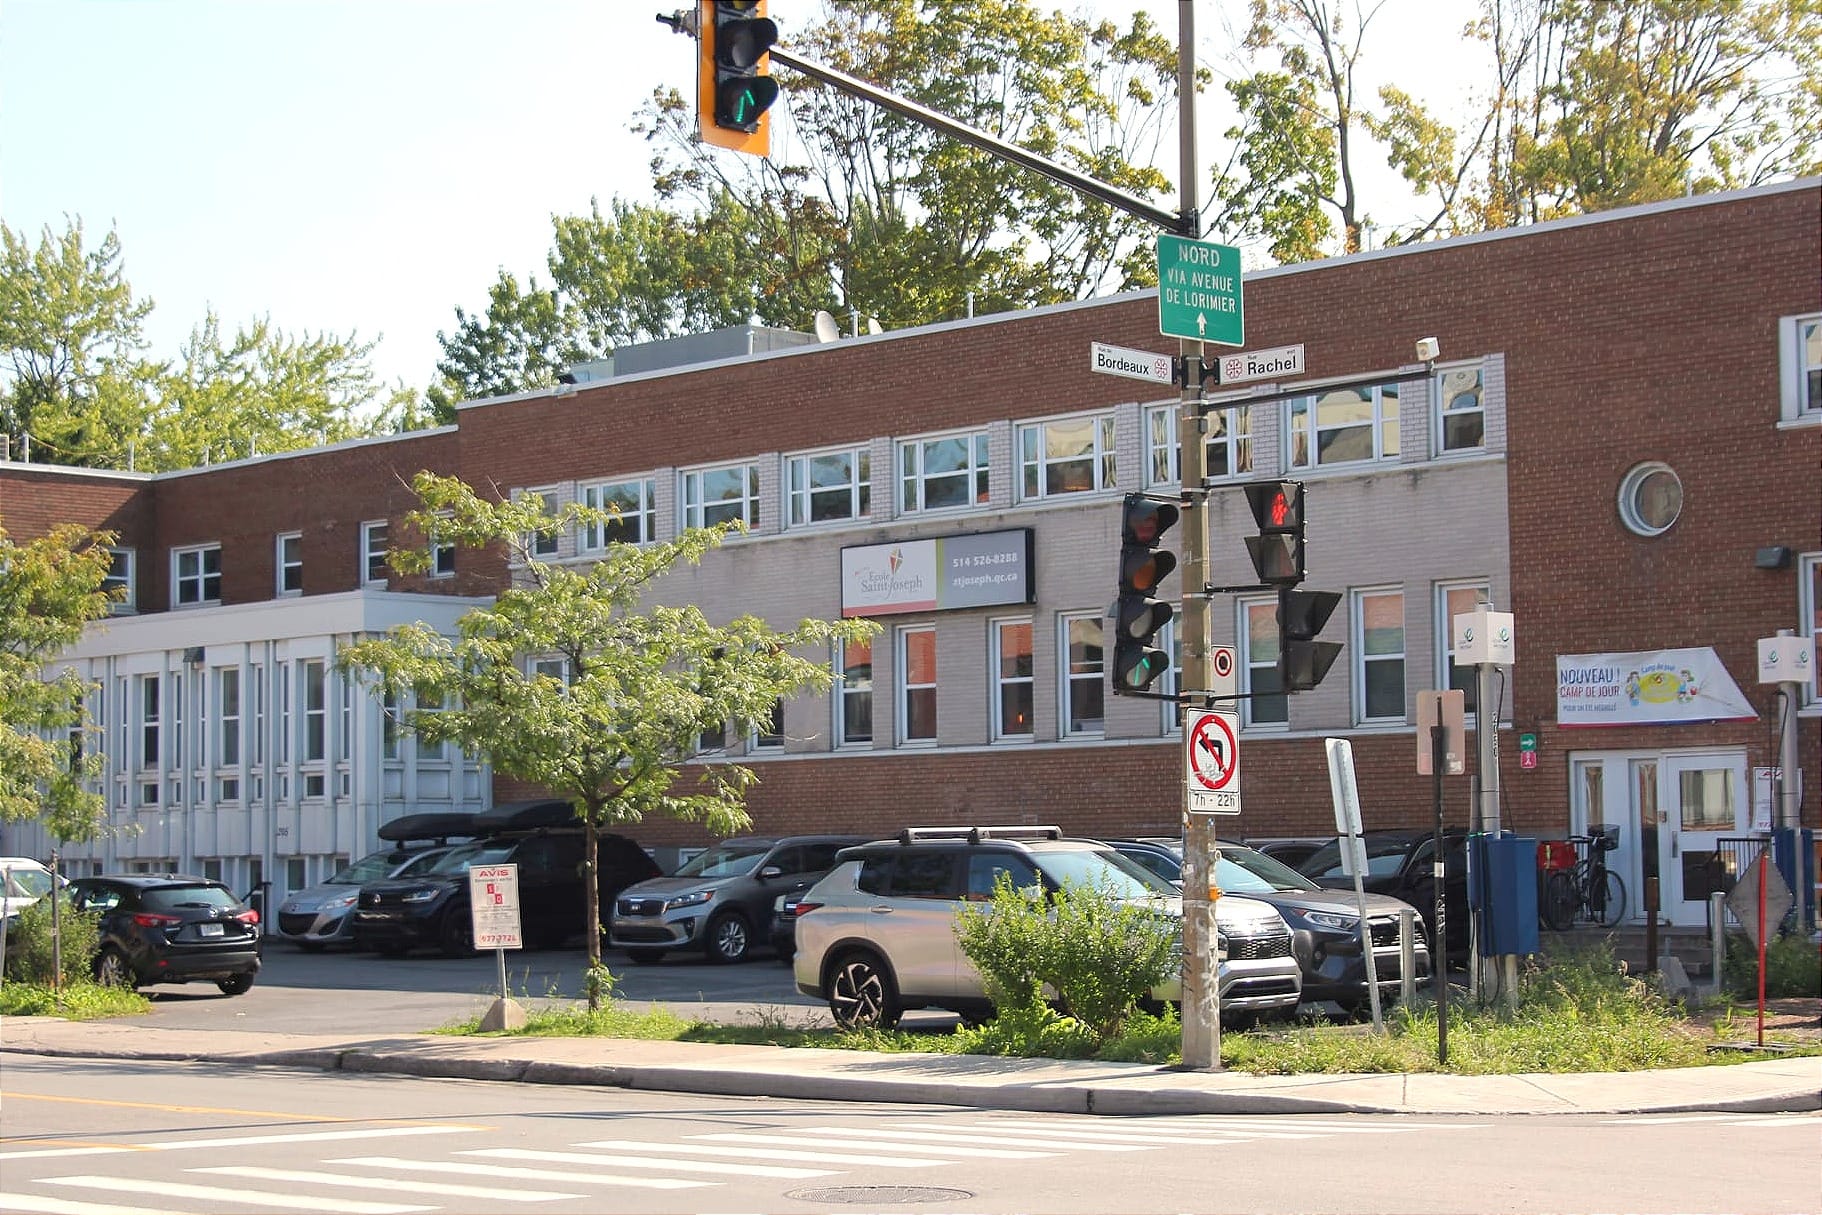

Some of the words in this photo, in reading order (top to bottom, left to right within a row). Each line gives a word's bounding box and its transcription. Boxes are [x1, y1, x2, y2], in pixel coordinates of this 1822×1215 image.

[1178, 243, 1221, 267] NORD
[1167, 268, 1187, 285] VIA
[1191, 271, 1234, 293] AVENUE
[1166, 287, 1180, 304] DE
[1184, 290, 1236, 313] LORIMIER
[1097, 353, 1150, 375] Bordeaux
[1247, 355, 1296, 375] Rachel
[952, 556, 971, 568] 514
[952, 573, 1018, 589] stjoseph.qc.ca
[1560, 667, 1614, 685] NOUVEAU
[1560, 686, 1584, 698] CAMP
[1586, 686, 1596, 697] DE
[1598, 685, 1620, 697] JOUR
[1194, 793, 1206, 806] 7h
[1217, 793, 1235, 807] 22h
[479, 869, 510, 878] AVIS
